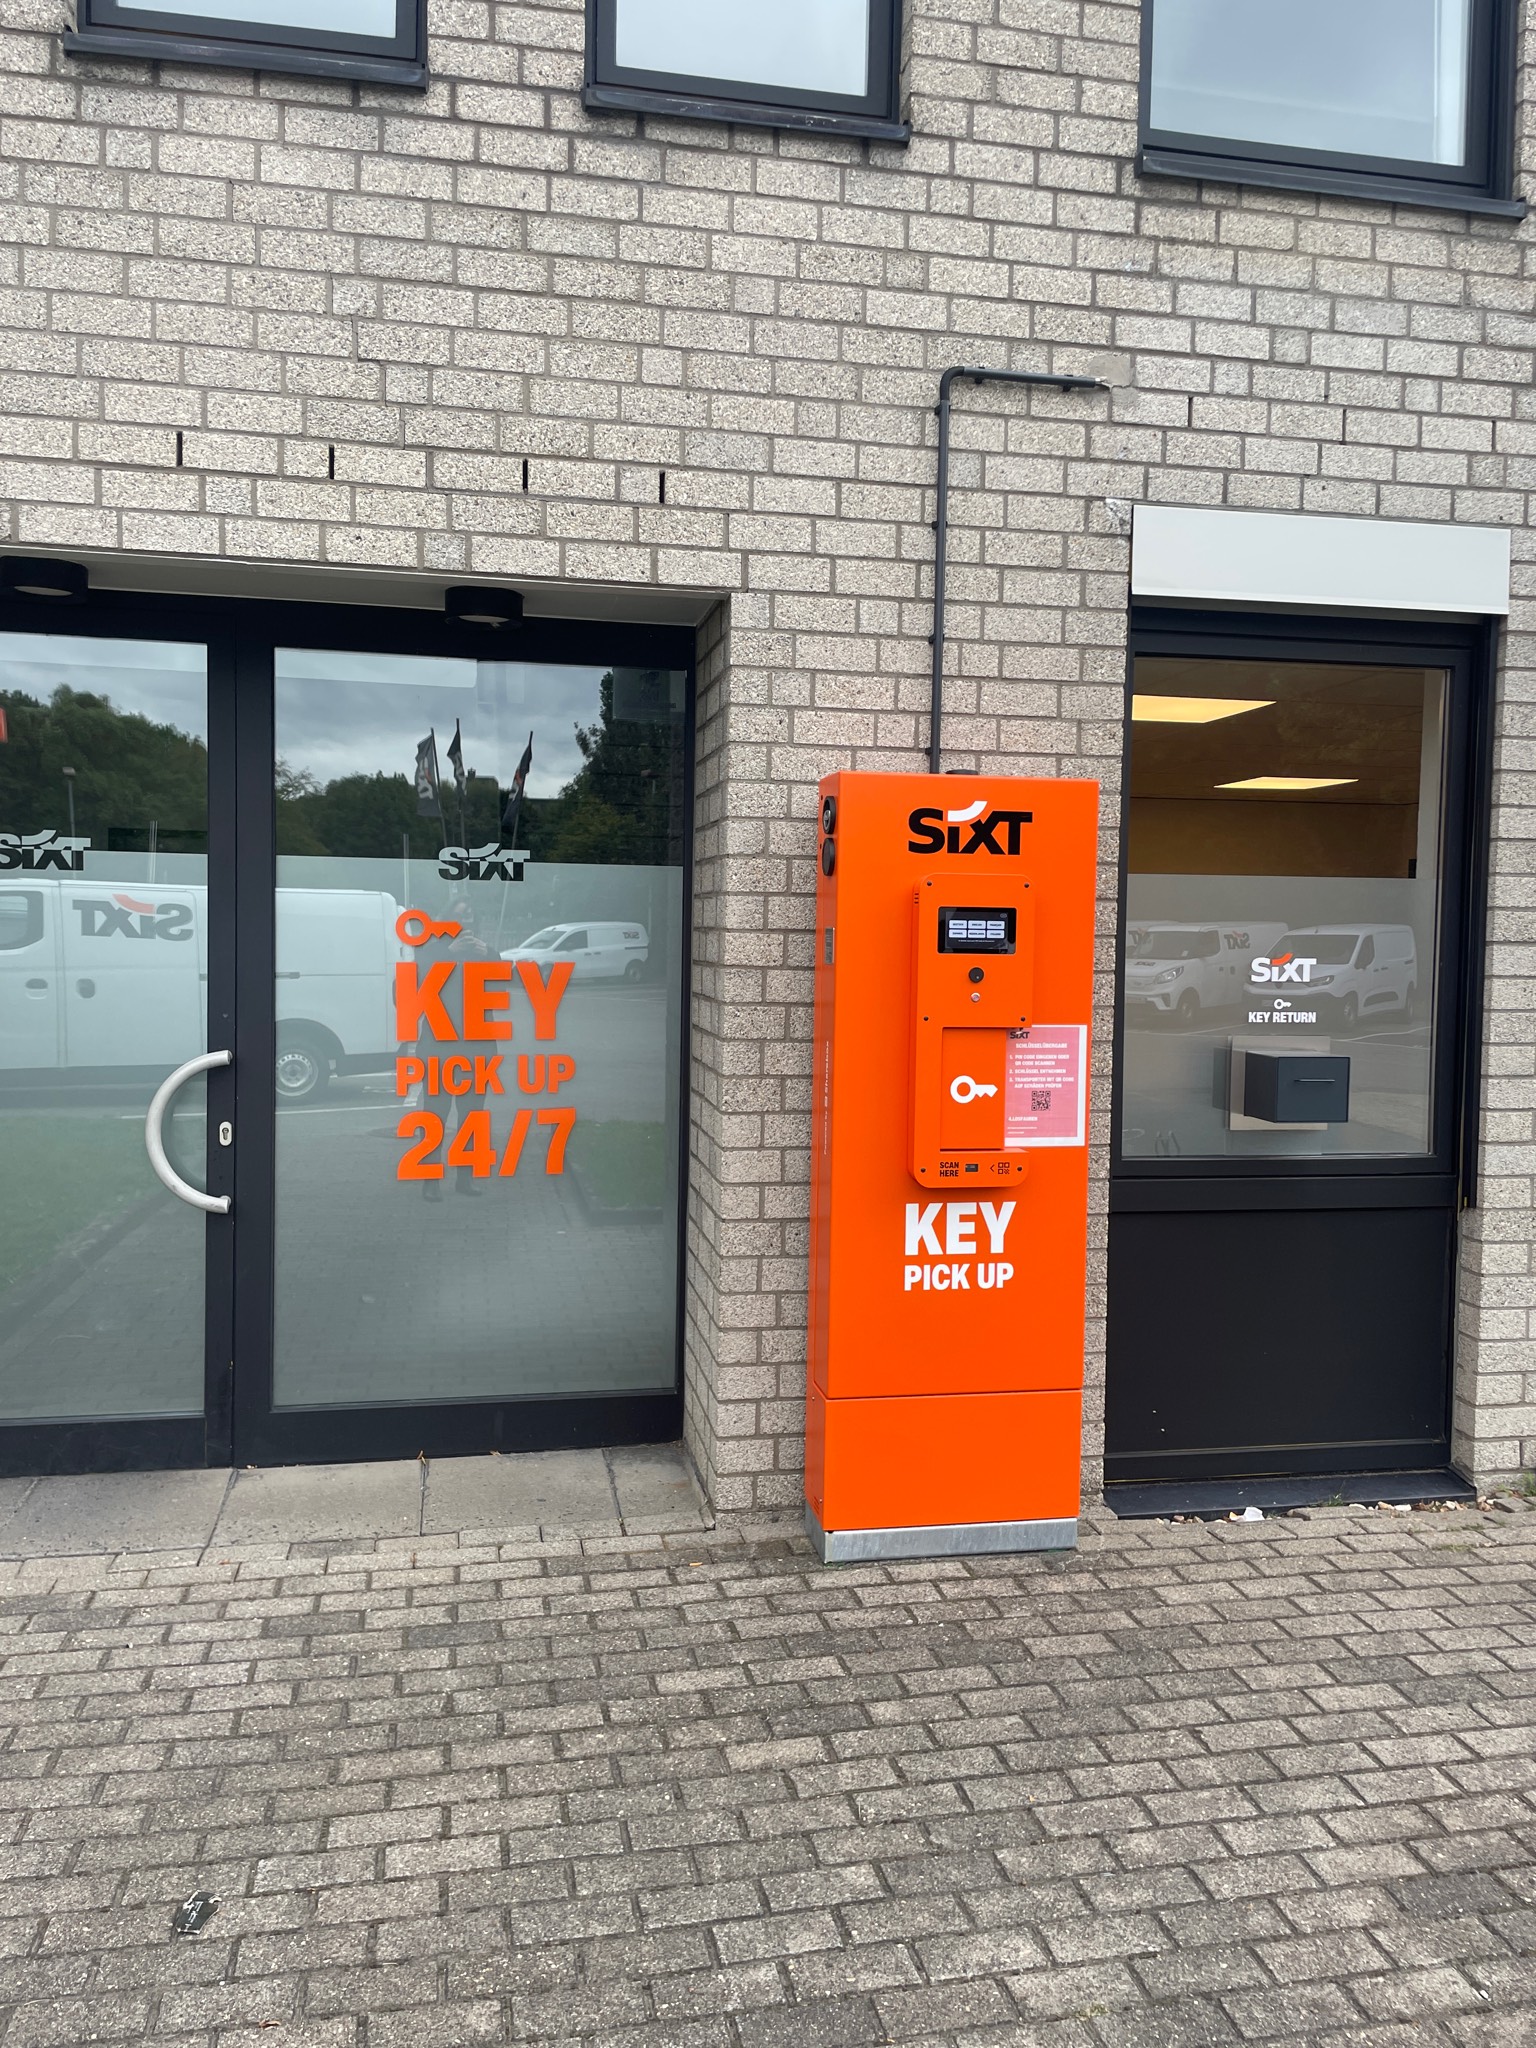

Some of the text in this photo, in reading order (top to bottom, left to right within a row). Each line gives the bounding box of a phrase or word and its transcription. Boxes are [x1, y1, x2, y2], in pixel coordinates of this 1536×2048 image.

[395, 961, 576, 1041] KEY
[1248, 1012, 1317, 1023] KEY RETURN
[395, 1055, 576, 1096] PICK UP
[396, 1107, 576, 1180] 24/7
[905, 1201, 1017, 1256] KEY
[904, 1262, 1014, 1291] PICK UP
